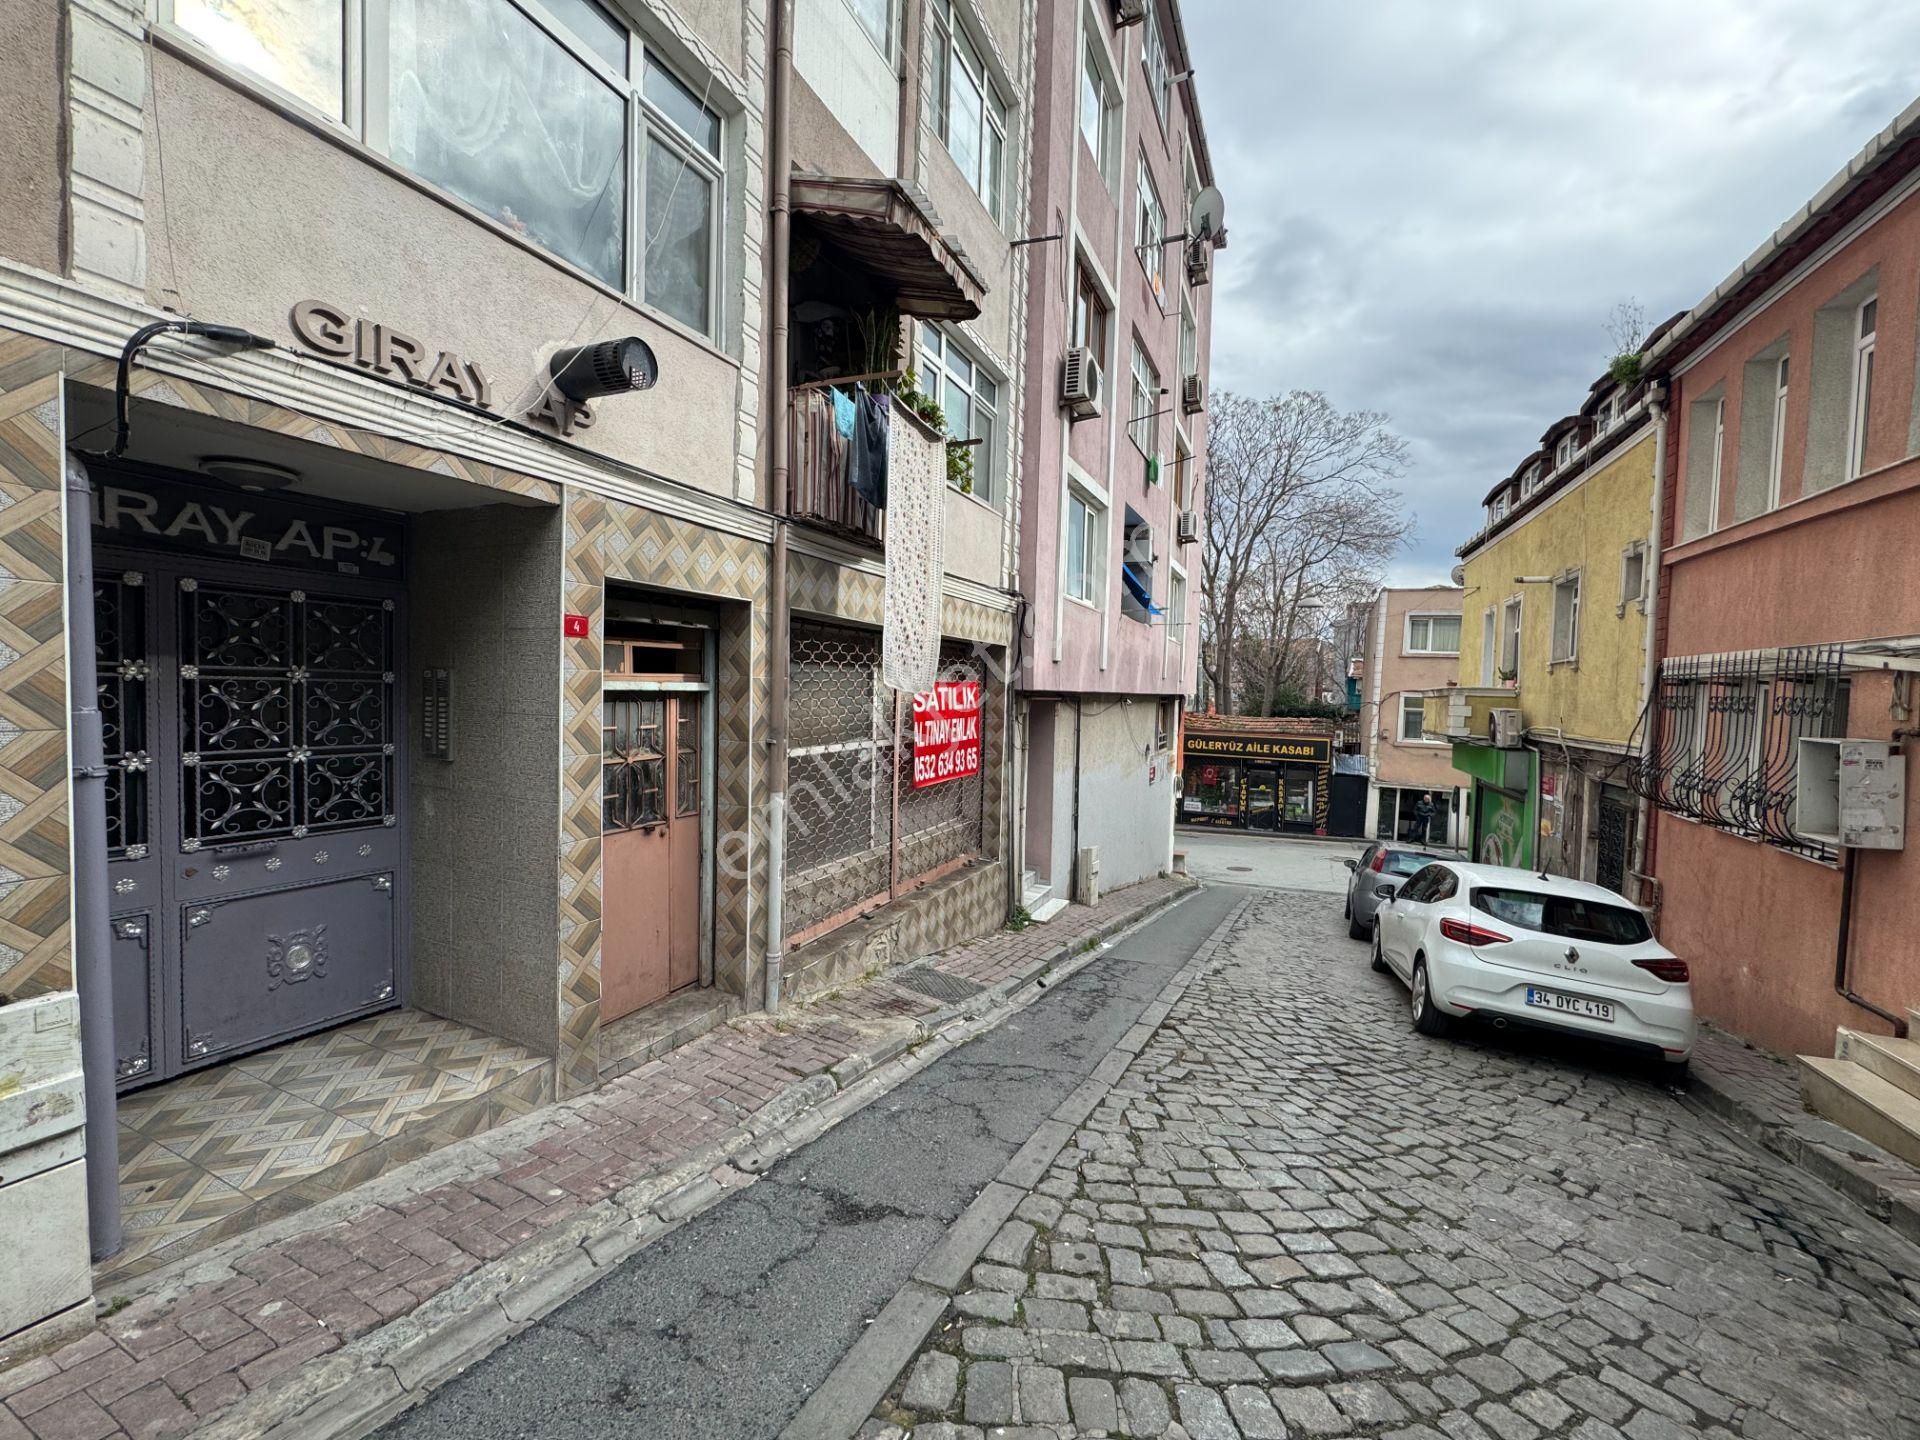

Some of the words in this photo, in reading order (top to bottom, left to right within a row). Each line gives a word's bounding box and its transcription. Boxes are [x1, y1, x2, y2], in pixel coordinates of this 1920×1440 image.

[573, 620, 580, 632] 4
[913, 686, 977, 713] SATILIK
[914, 719, 951, 748] ALTINAY
[1187, 739, 1243, 752] GÜLERYÜZ
[1245, 740, 1270, 753] AİLE
[1272, 744, 1314, 756] KASABI
[914, 754, 936, 782] 0532
[937, 750, 954, 777] 634
[955, 749, 966, 773] 93
[966, 746, 978, 770] 65
[1553, 963, 1588, 974] CLIO
[1535, 991, 1550, 1005] 34
[1556, 995, 1580, 1011] DYC
[1585, 1001, 1609, 1017] 419
